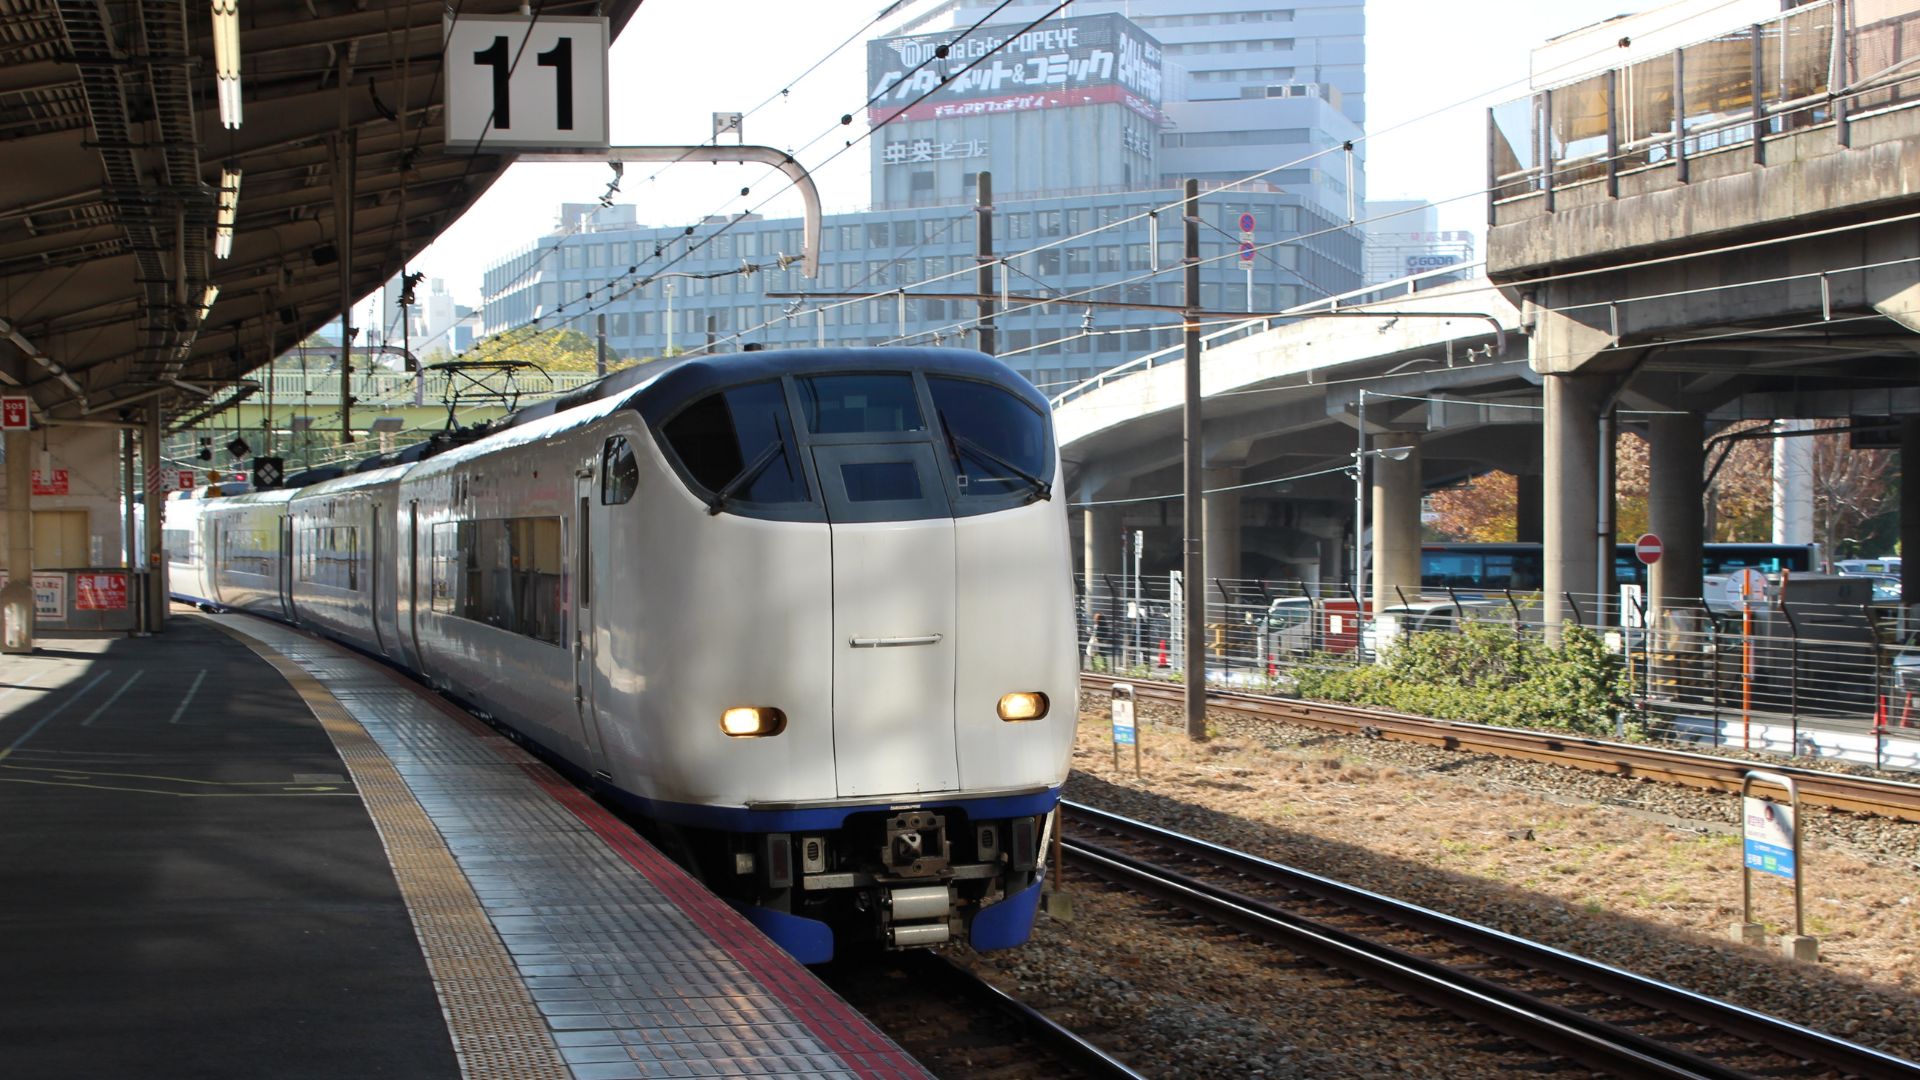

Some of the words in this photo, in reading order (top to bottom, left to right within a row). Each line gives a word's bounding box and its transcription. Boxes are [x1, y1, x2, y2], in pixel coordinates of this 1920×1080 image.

[1007, 27, 1079, 53] POPEYE
[474, 36, 573, 130] 11
[886, 138, 983, 165] 中央ビル
[5, 402, 25, 410] SOS
